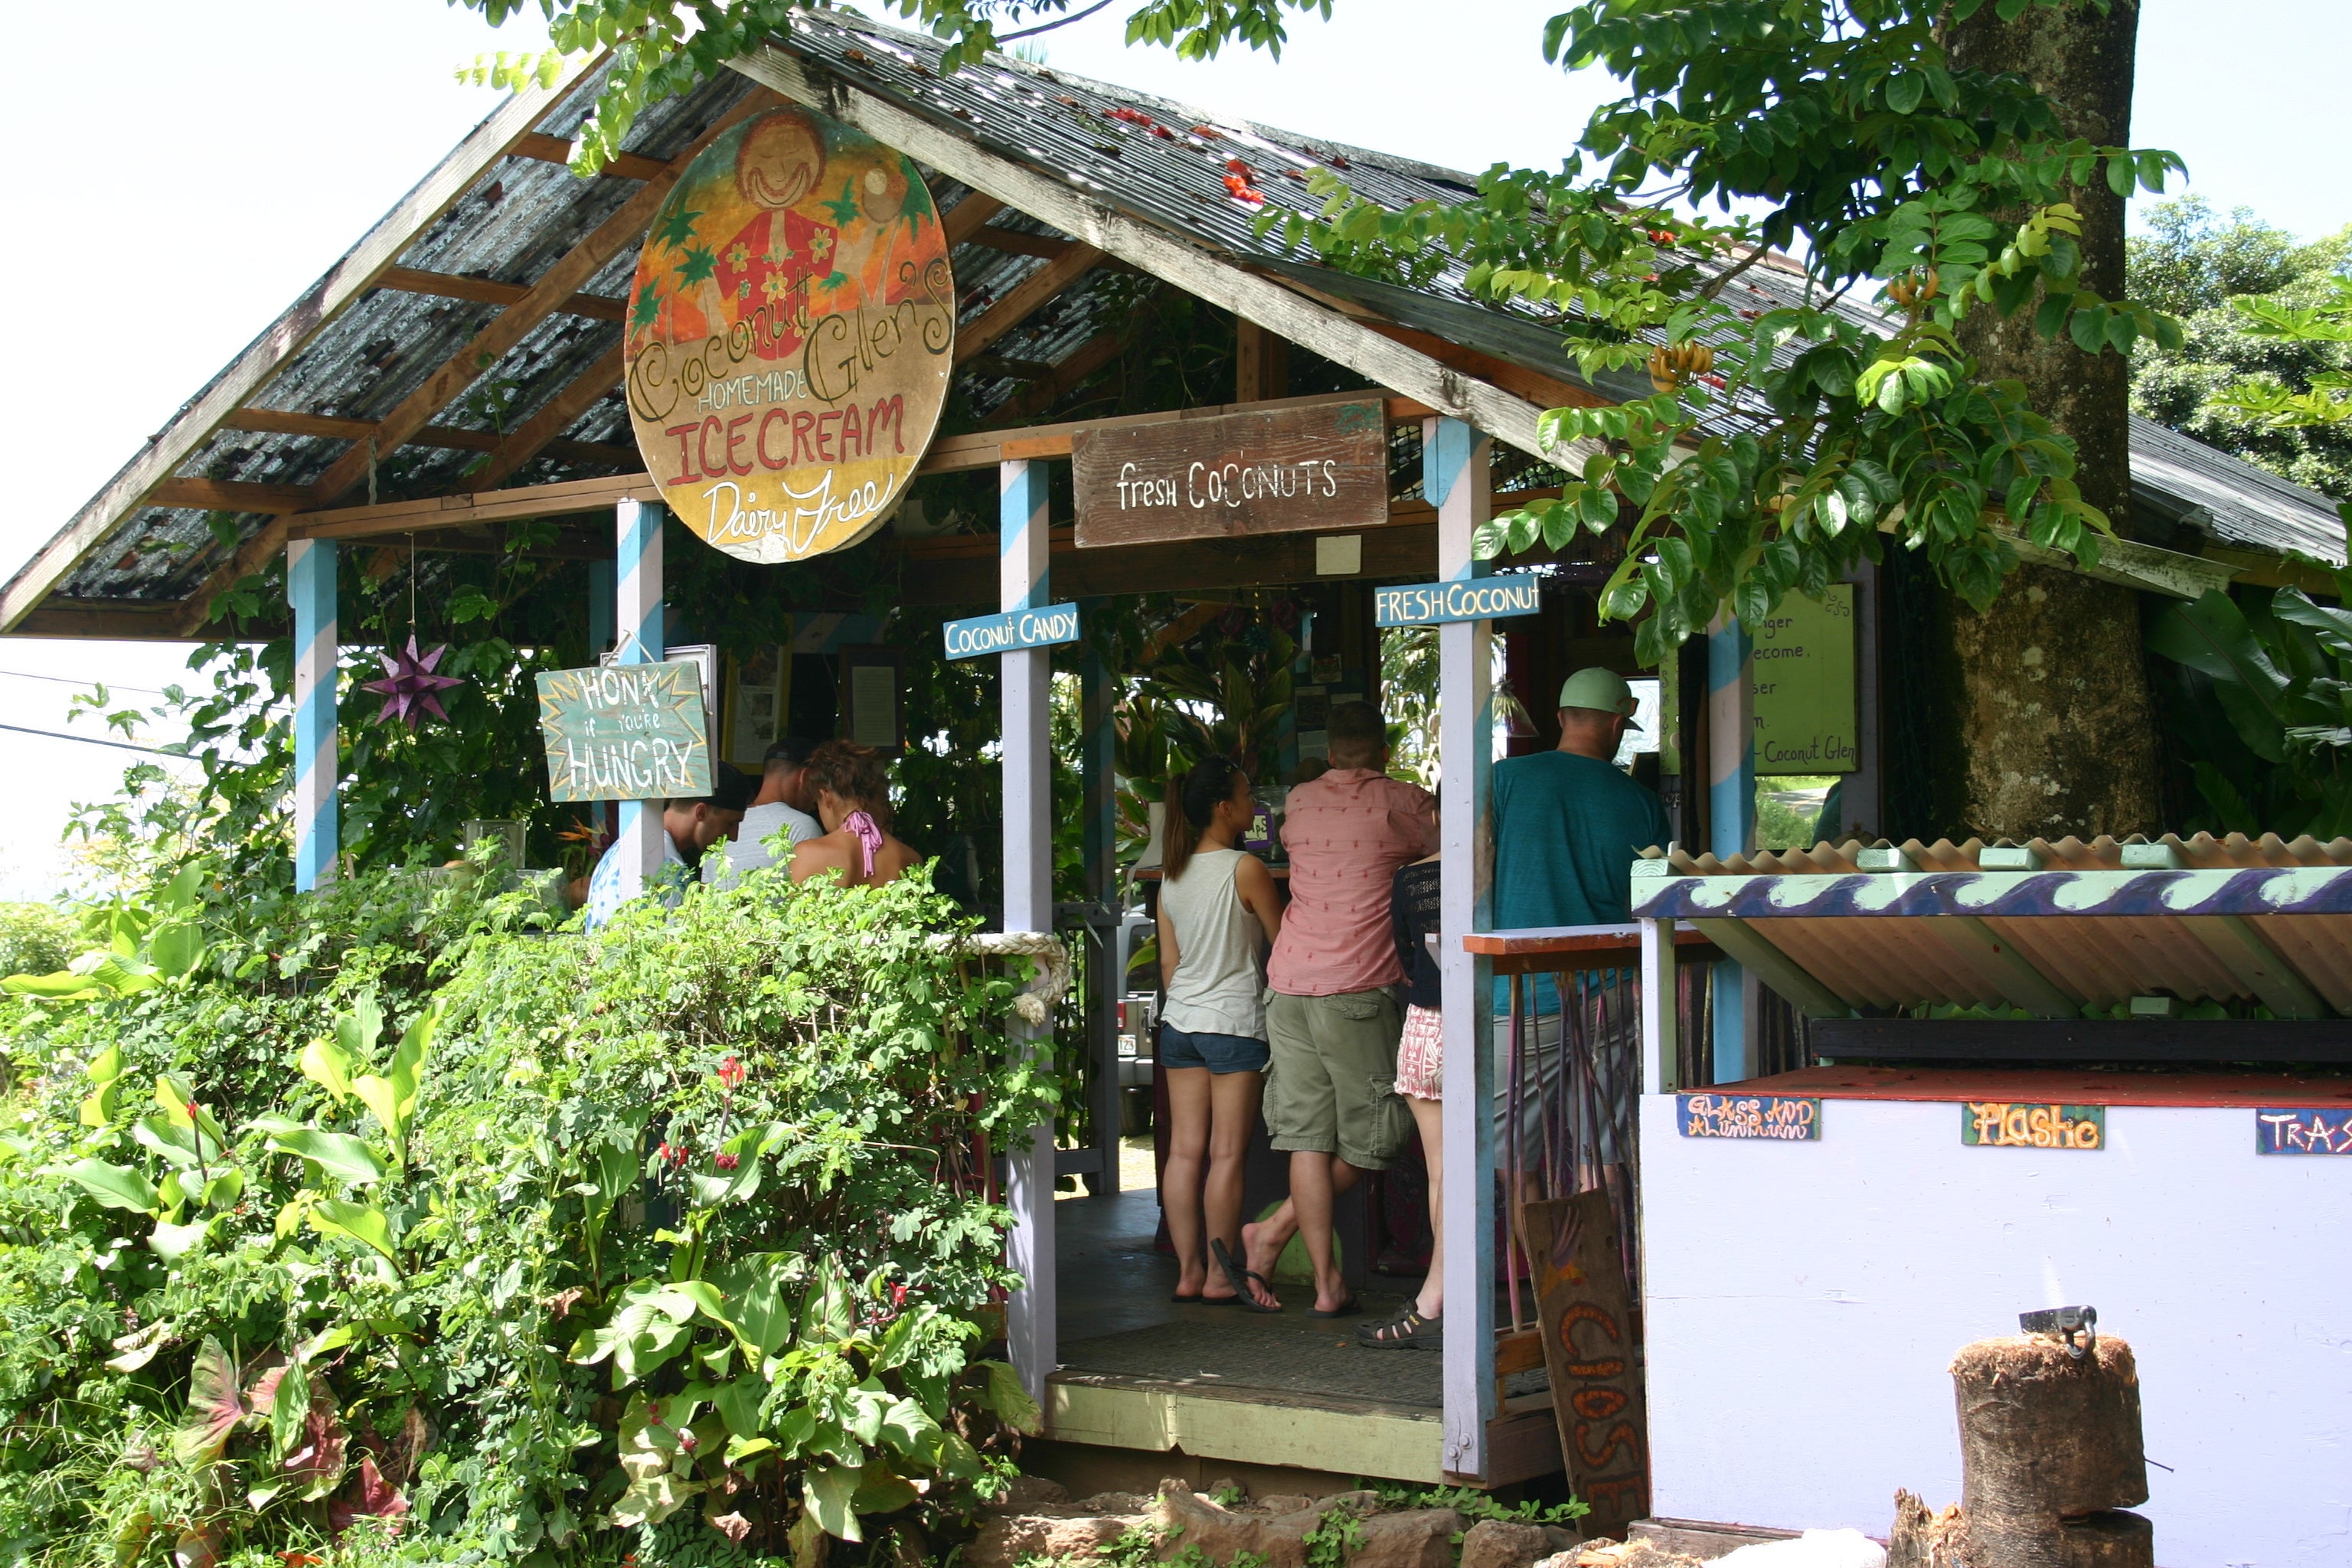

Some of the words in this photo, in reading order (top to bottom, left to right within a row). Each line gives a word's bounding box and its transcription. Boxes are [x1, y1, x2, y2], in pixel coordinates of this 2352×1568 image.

[697, 368, 808, 413] HOMEMADE
[665, 413, 753, 485] ICE
[757, 394, 905, 470] CREAM
[702, 481, 791, 551] Dairy
[782, 469, 893, 554] Free
[1377, 589, 1445, 622] FRESH
[1019, 612, 1077, 643] CANDY
[577, 669, 661, 710] HONK
[584, 717, 596, 738] if
[567, 737, 693, 792] HUNGRY
[1765, 737, 1820, 765] Coconut
[1824, 735, 1856, 766] Glen
[1687, 1096, 1762, 1126] GLASS
[1765, 1097, 1815, 1127] AND
[1968, 1102, 2100, 1148] Plastic
